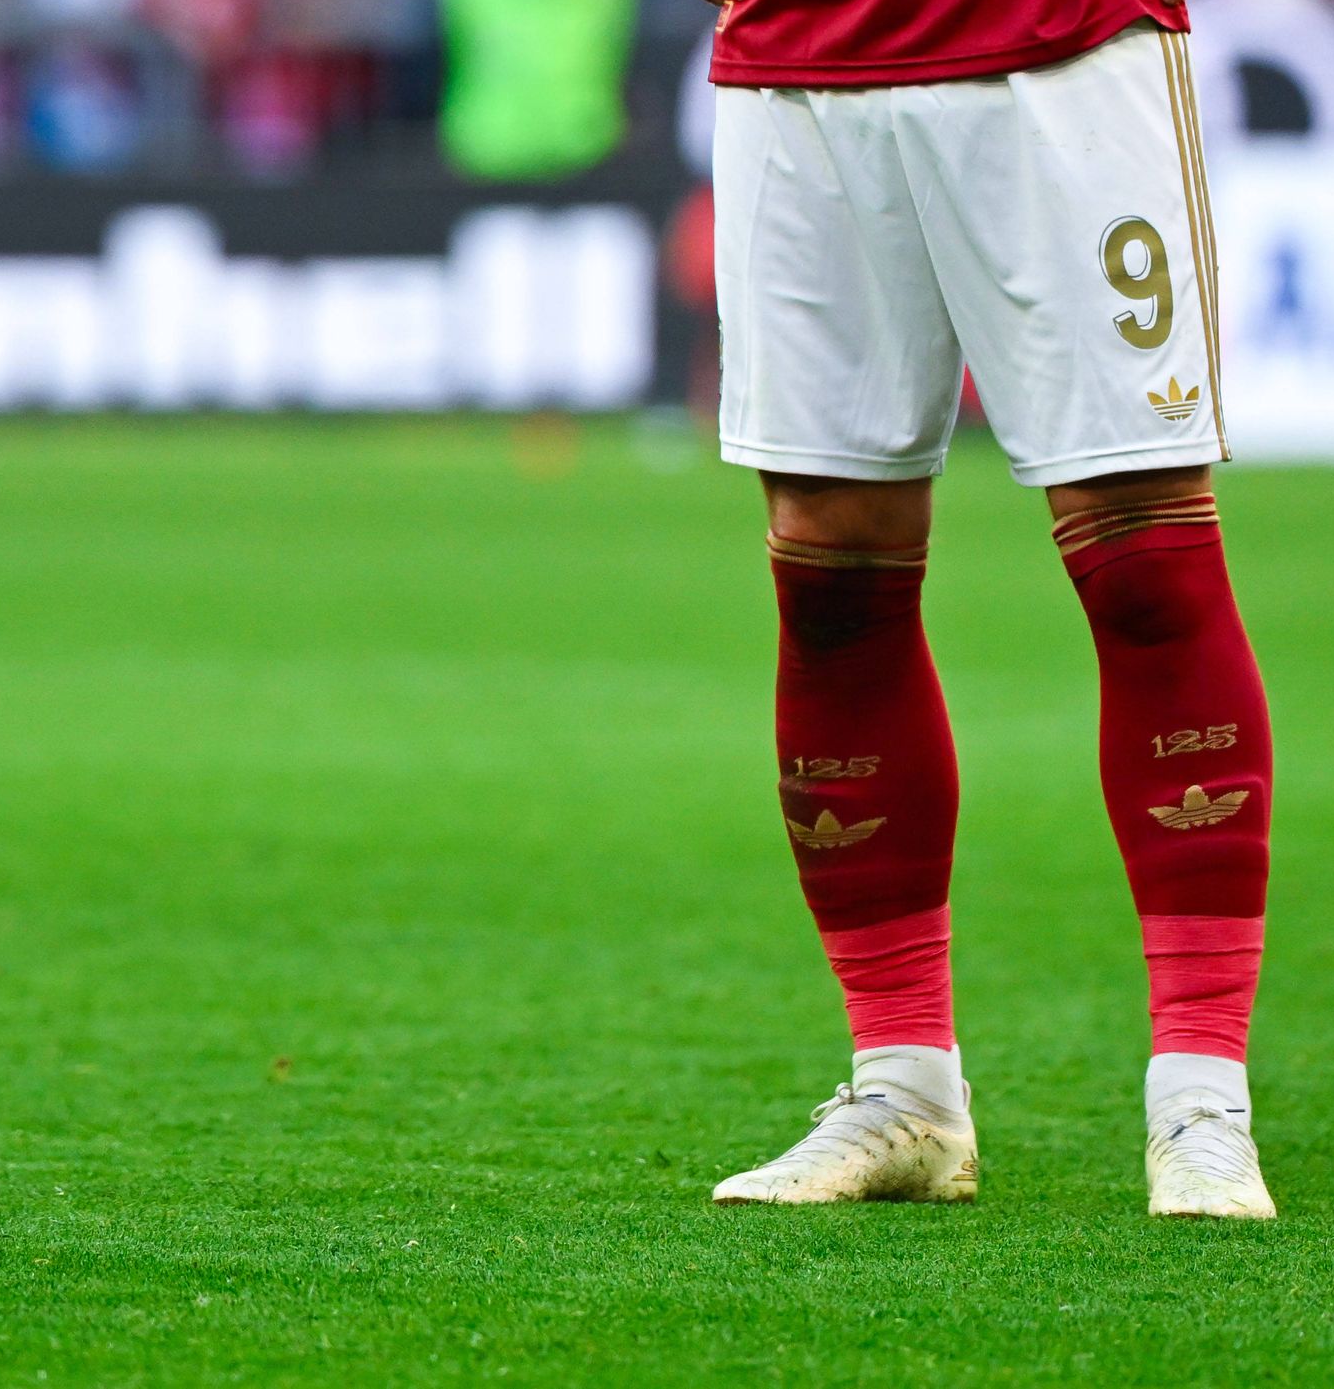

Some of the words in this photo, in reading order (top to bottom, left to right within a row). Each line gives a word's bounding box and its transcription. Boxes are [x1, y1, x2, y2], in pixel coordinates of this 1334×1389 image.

[1099, 215, 1173, 350] 9
[1151, 723, 1238, 758] 125
[793, 756, 881, 778] 125
